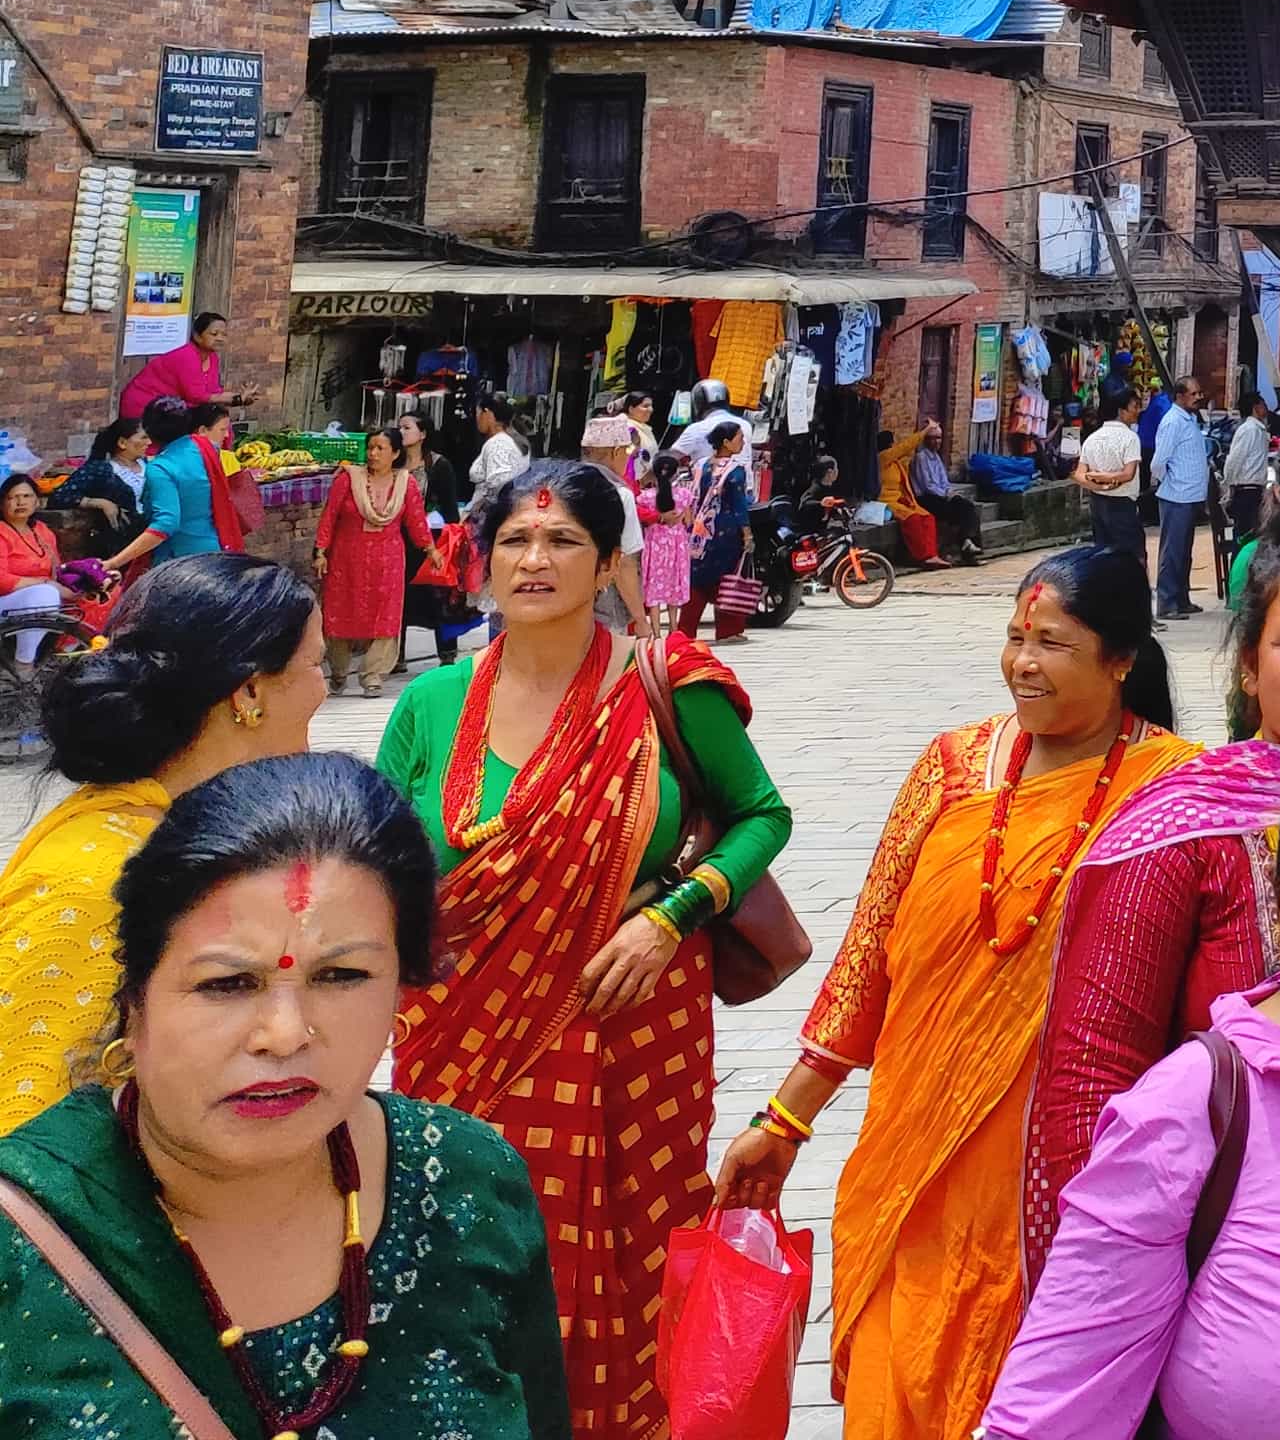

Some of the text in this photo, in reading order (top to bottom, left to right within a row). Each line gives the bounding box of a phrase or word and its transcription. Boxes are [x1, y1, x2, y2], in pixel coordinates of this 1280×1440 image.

[167, 54, 260, 79] BED & BREAKFAST
[221, 86, 255, 97] HOUSE
[296, 294, 432, 315] PARLOUR
